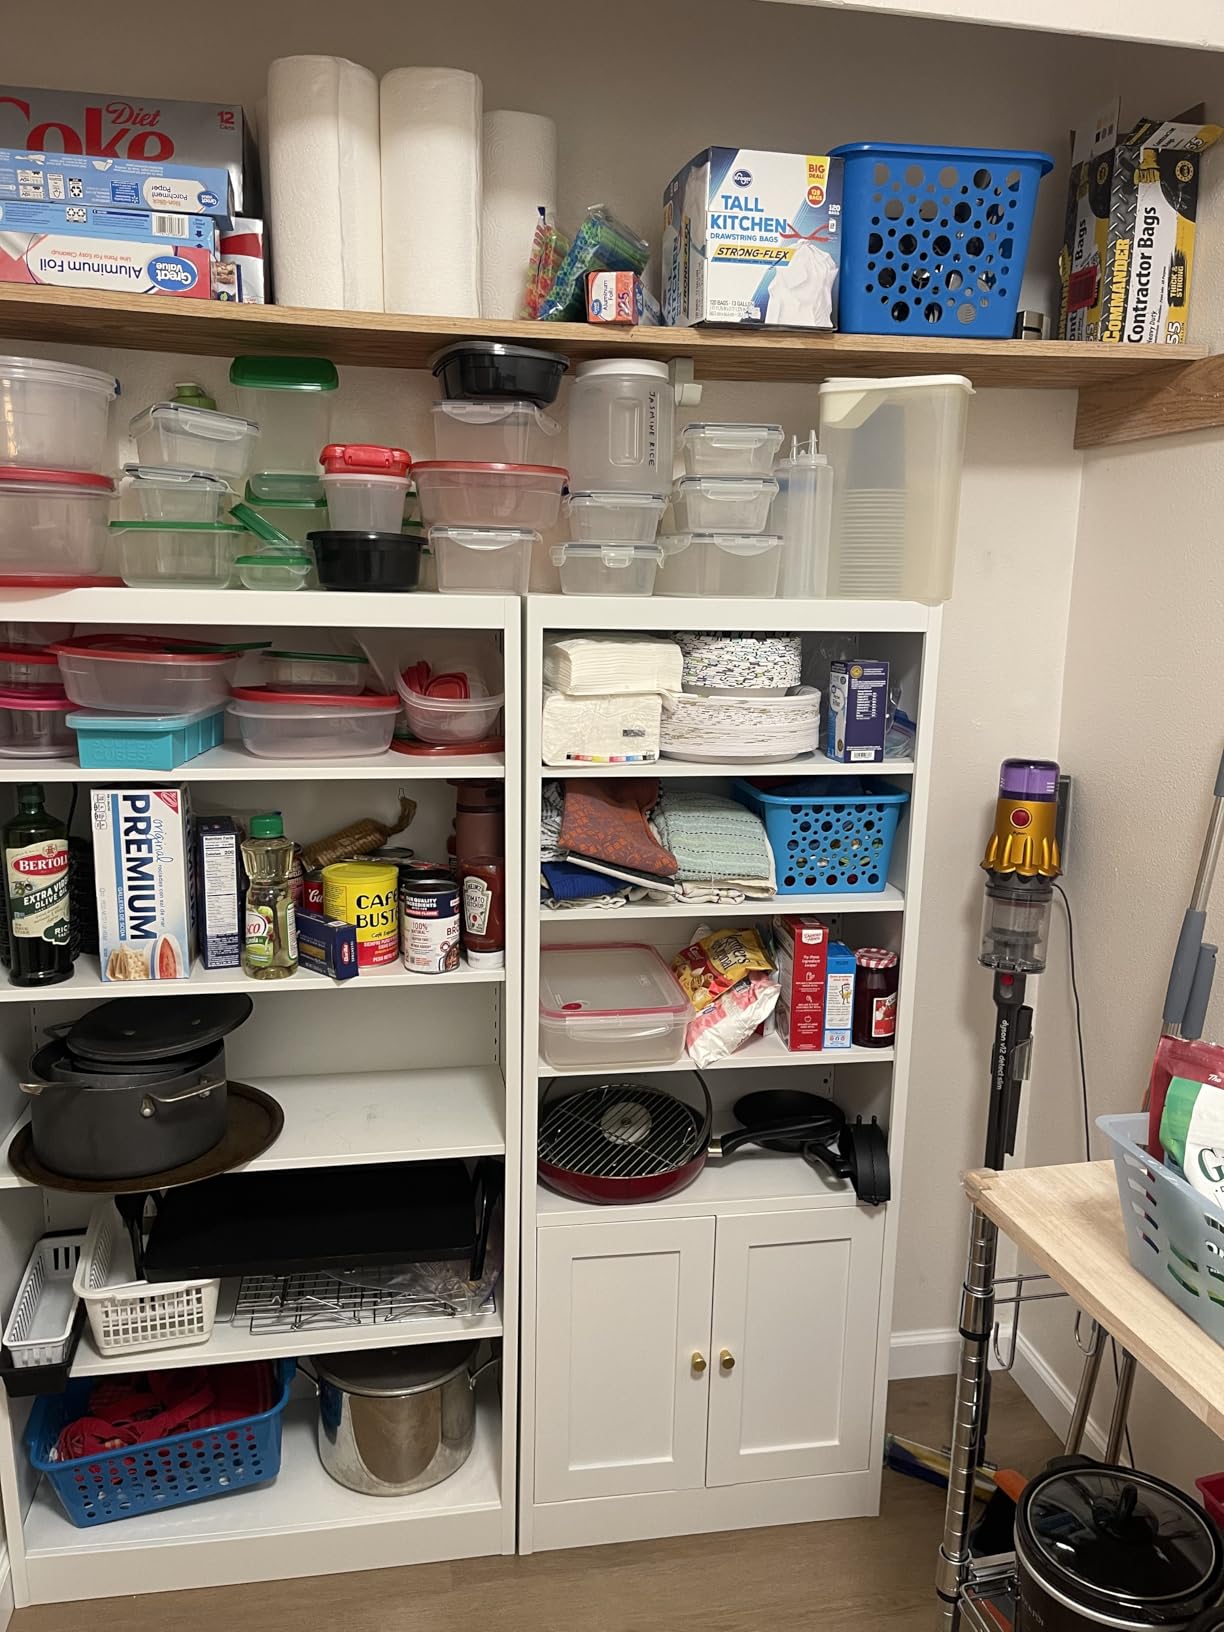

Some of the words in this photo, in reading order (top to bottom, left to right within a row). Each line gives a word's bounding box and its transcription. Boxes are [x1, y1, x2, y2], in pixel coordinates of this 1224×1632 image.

[105, 102, 160, 127] Diet
[217, 111, 234, 124] 12
[0, 96, 174, 163] oke
[734, 172, 752, 184] Kroger
[808, 164, 825, 173] BIG
[151, 185, 172, 193] Paper
[721, 195, 764, 212] TALL
[710, 214, 788, 233] KITCHEN
[1137, 206, 1160, 249] Bags
[710, 232, 758, 241] DRAWSTRING
[759, 235, 779, 243] BAGS
[1075, 219, 1088, 261] Bags
[717, 247, 790, 260] STRONG-FLEX
[39, 258, 65, 273] Foil
[67, 262, 143, 280] Aluminum
[155, 262, 183, 273] Value
[156, 269, 192, 285] Great
[1169, 272, 1177, 298] THICK
[1176, 265, 1184, 298] STRONG
[1103, 239, 1130, 343] COMMANDER
[1128, 252, 1152, 343] Contractor
[1166, 320, 1181, 344] 55
[648, 391, 656, 436] JASMINE
[145, 819, 174, 863] original
[122, 794, 158, 940] PREMIUM
[23, 887, 53, 906] EXTRA
[34, 893, 57, 909] OLIVE
[412, 922, 428, 931] 100%
[1000, 1020, 1009, 1041] dyson
[997, 1055, 1006, 1077] detect
[996, 1076, 1005, 1091] slim
[1207, 1073, 1222, 1083] The
